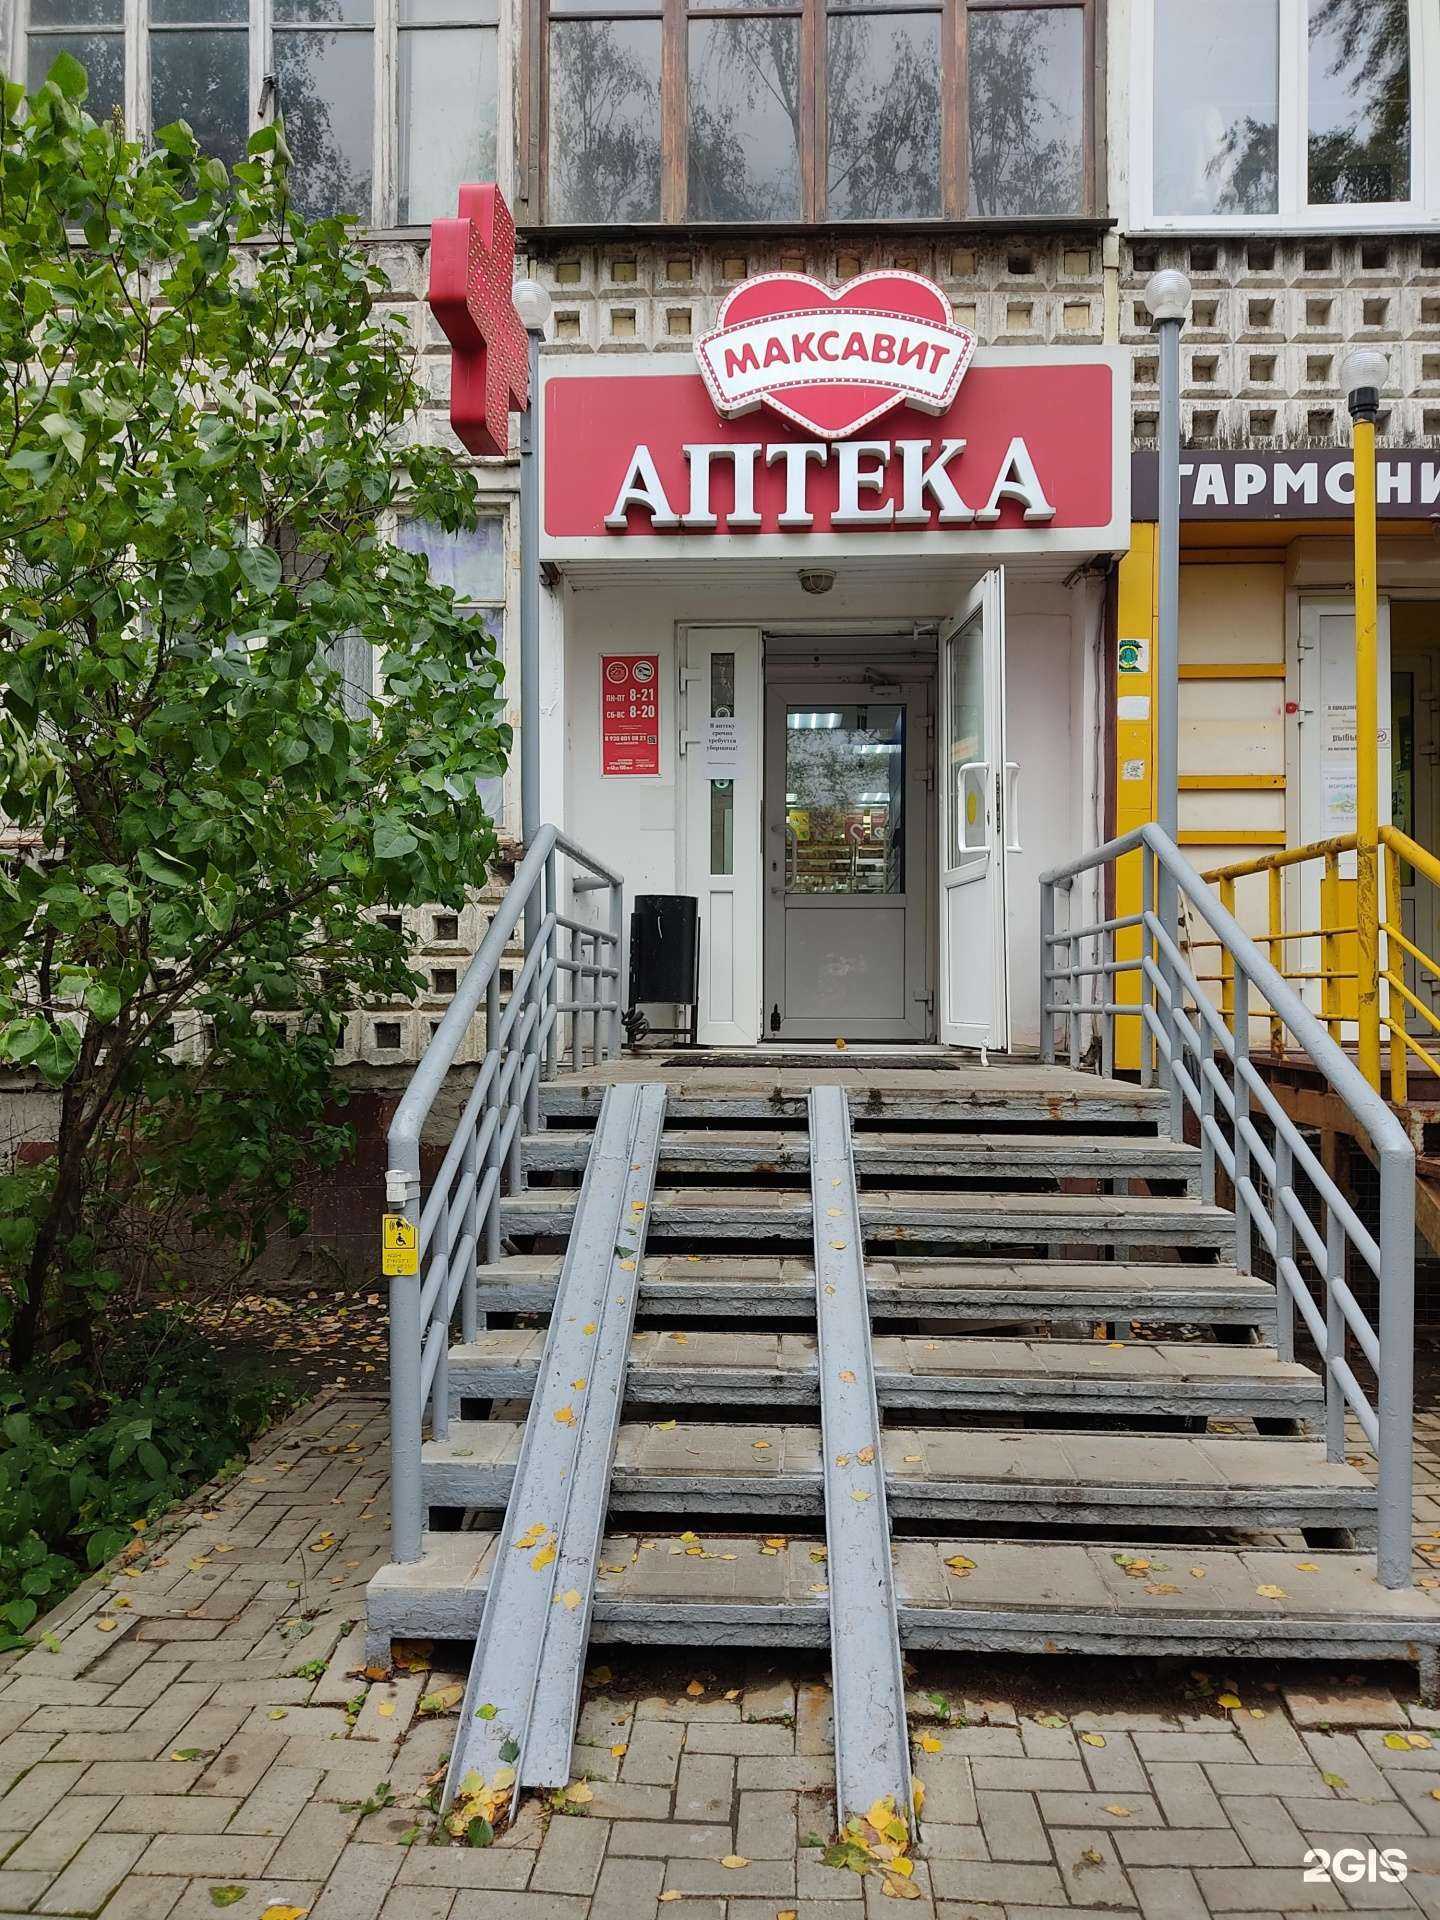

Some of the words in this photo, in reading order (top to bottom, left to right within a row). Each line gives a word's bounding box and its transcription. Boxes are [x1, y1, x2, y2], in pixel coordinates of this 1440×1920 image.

[724, 330, 951, 379] МАКСАВИТ
[603, 437, 1057, 528] АПТЕКА
[629, 688, 654, 702] 8-21
[629, 705, 655, 718] 8-20
